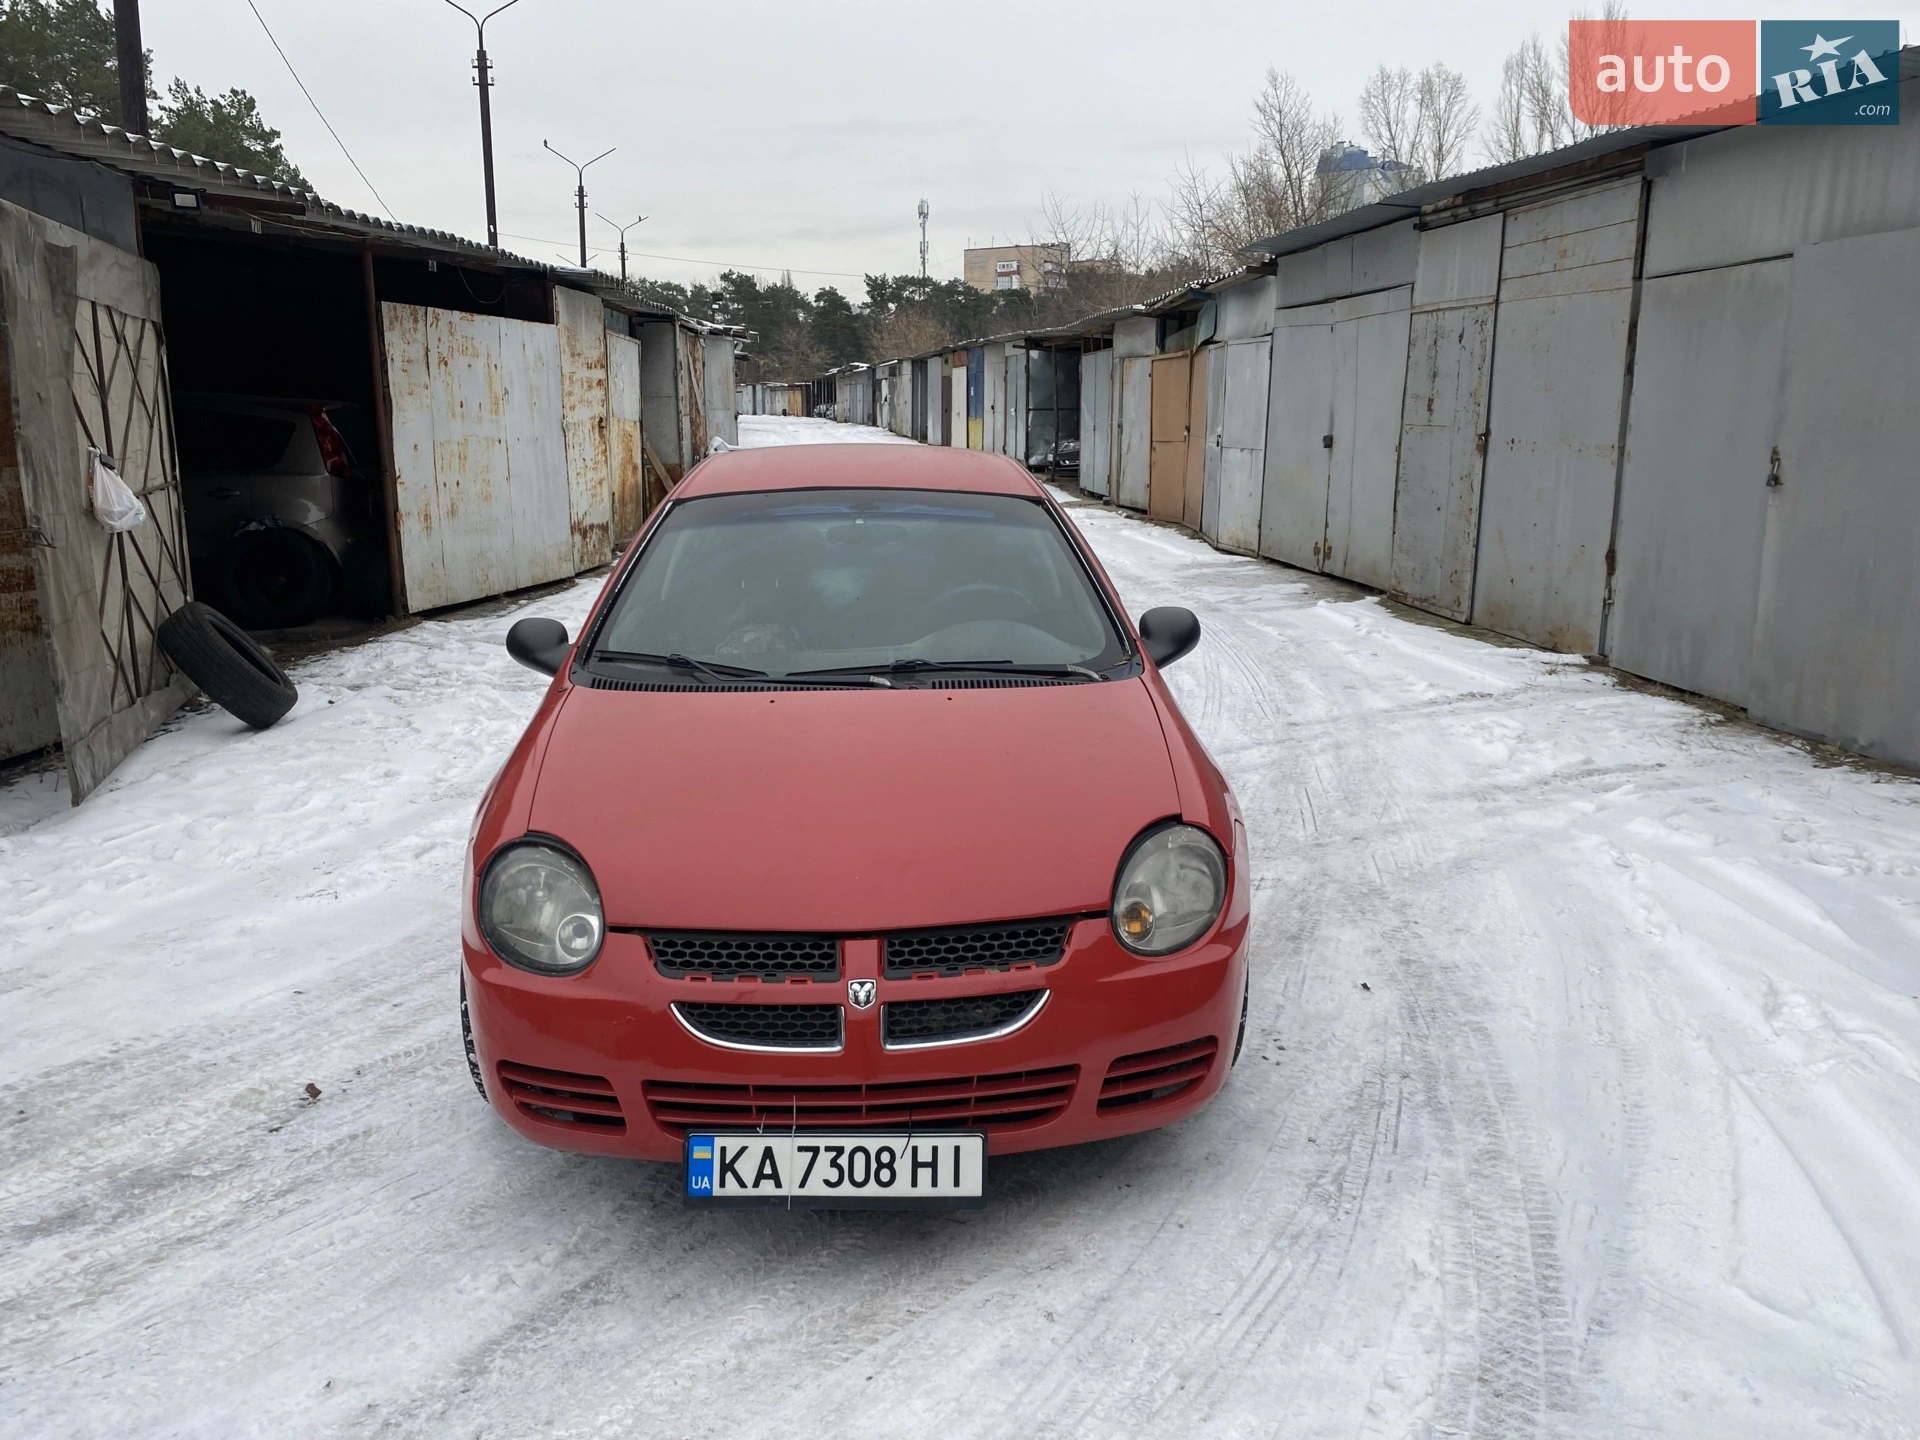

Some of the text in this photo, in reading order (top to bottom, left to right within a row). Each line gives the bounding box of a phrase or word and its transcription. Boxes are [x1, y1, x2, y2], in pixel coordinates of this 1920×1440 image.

[718, 1145, 961, 1189] KA 7308 HI
[692, 1176, 711, 1190] UA
